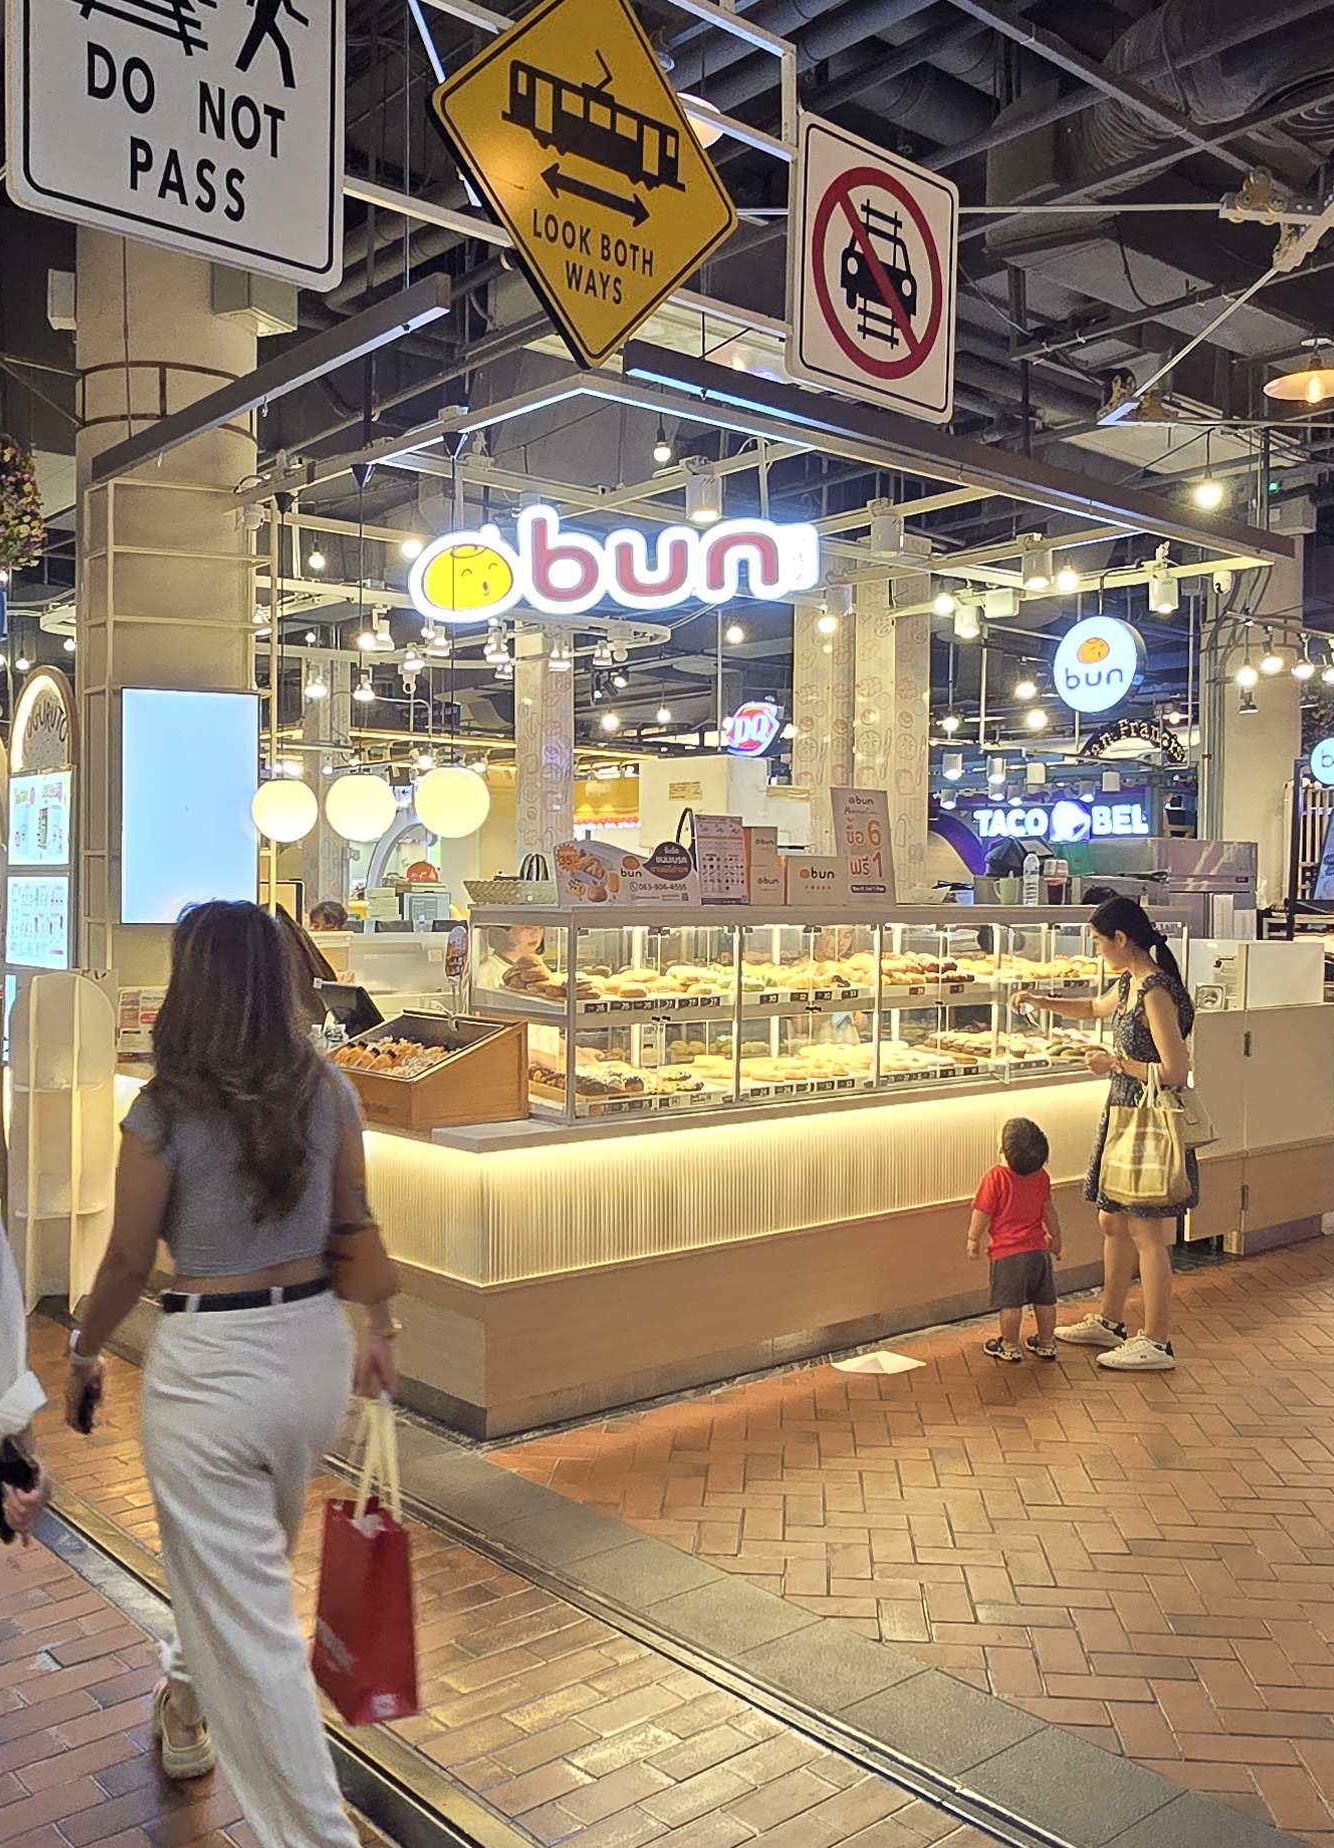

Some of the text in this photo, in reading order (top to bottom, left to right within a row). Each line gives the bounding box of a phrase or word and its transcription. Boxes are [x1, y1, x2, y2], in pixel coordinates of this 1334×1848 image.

[86, 43, 286, 160] DO NOT
[128, 136, 247, 223] PASS
[531, 208, 656, 277] LOOK BOTH
[563, 261, 625, 305] WAYS
[1064, 667, 1124, 690] bun
[733, 713, 771, 744] DQ
[855, 795, 874, 805] bun
[867, 819, 883, 847] 6
[972, 807, 1049, 838] TACO
[620, 868, 643, 878] bun
[810, 866, 836, 879] bun
[850, 856, 871, 876] ฟรี
[872, 851, 883, 878] 1
